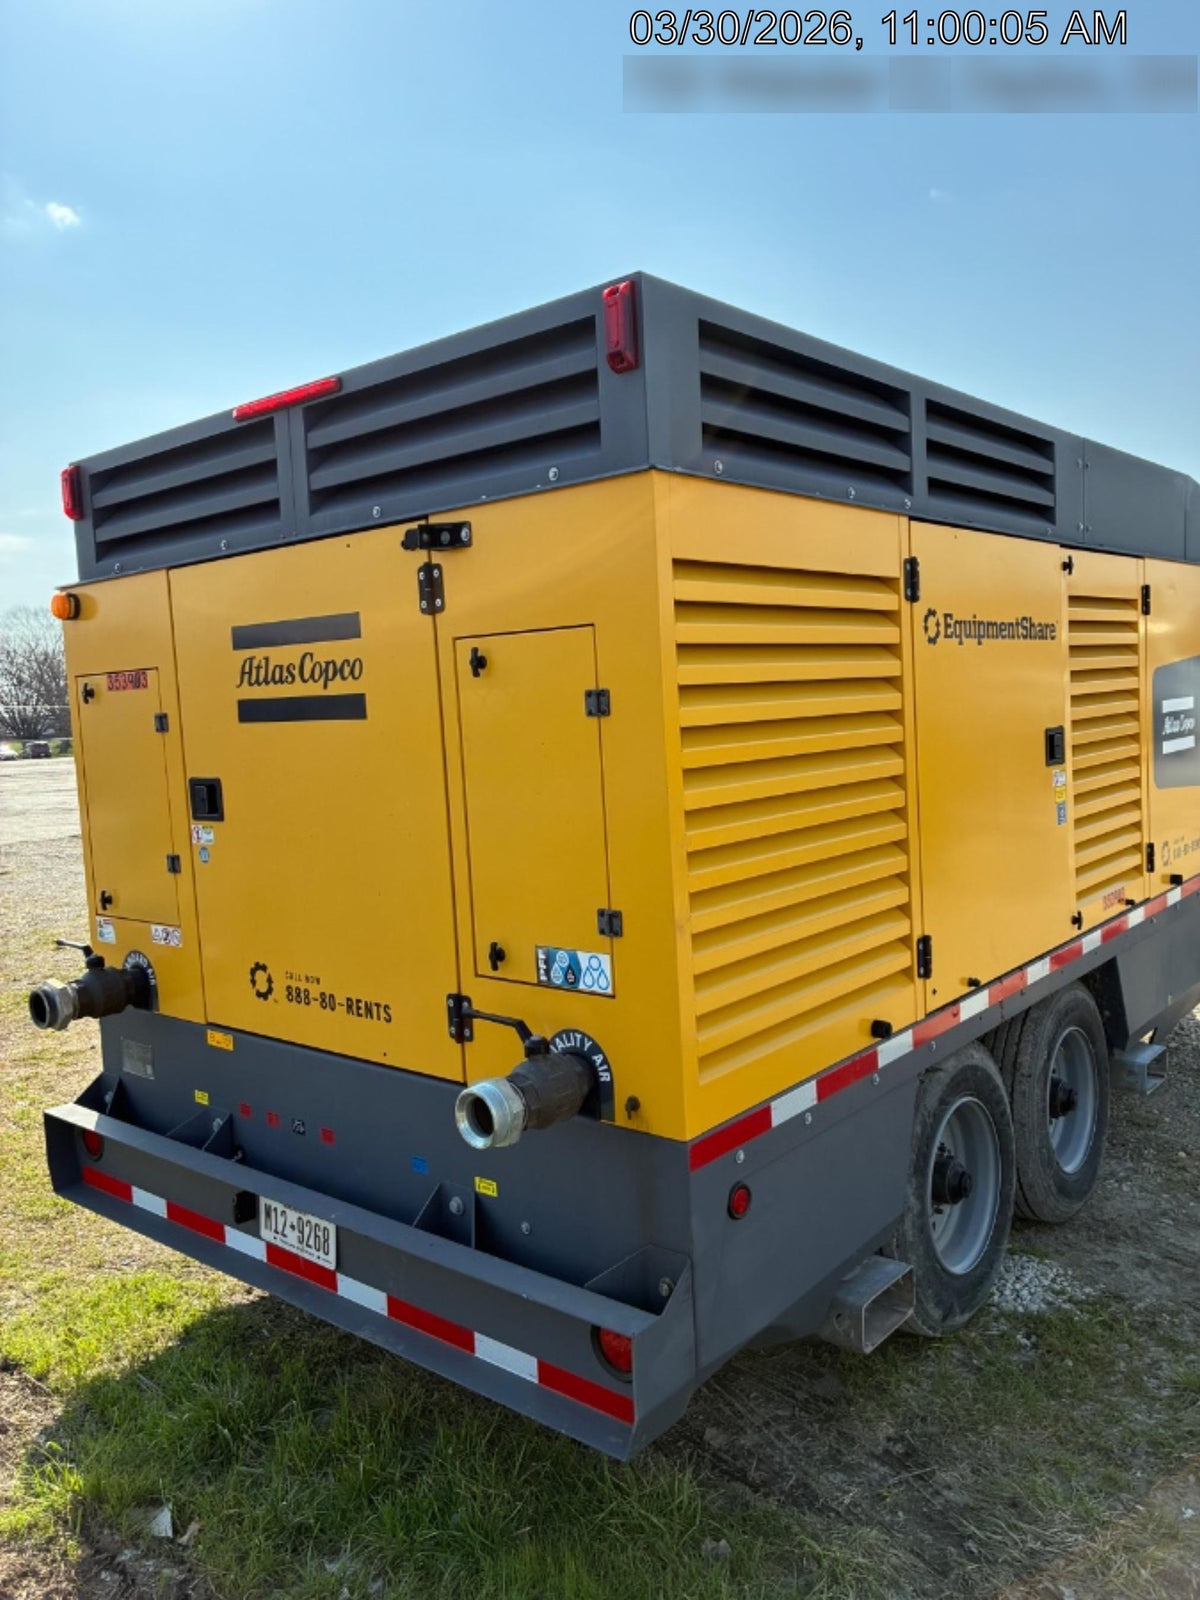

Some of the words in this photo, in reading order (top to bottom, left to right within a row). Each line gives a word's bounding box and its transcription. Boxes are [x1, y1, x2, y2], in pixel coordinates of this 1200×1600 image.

[943, 613, 1056, 645] EquipmentShare
[236, 656, 296, 688] Atlas
[298, 651, 363, 690] Copco
[286, 985, 392, 1023] 888-80-RENTS
[549, 1032, 593, 1053] ALITY
[592, 1054, 610, 1081] AIR
